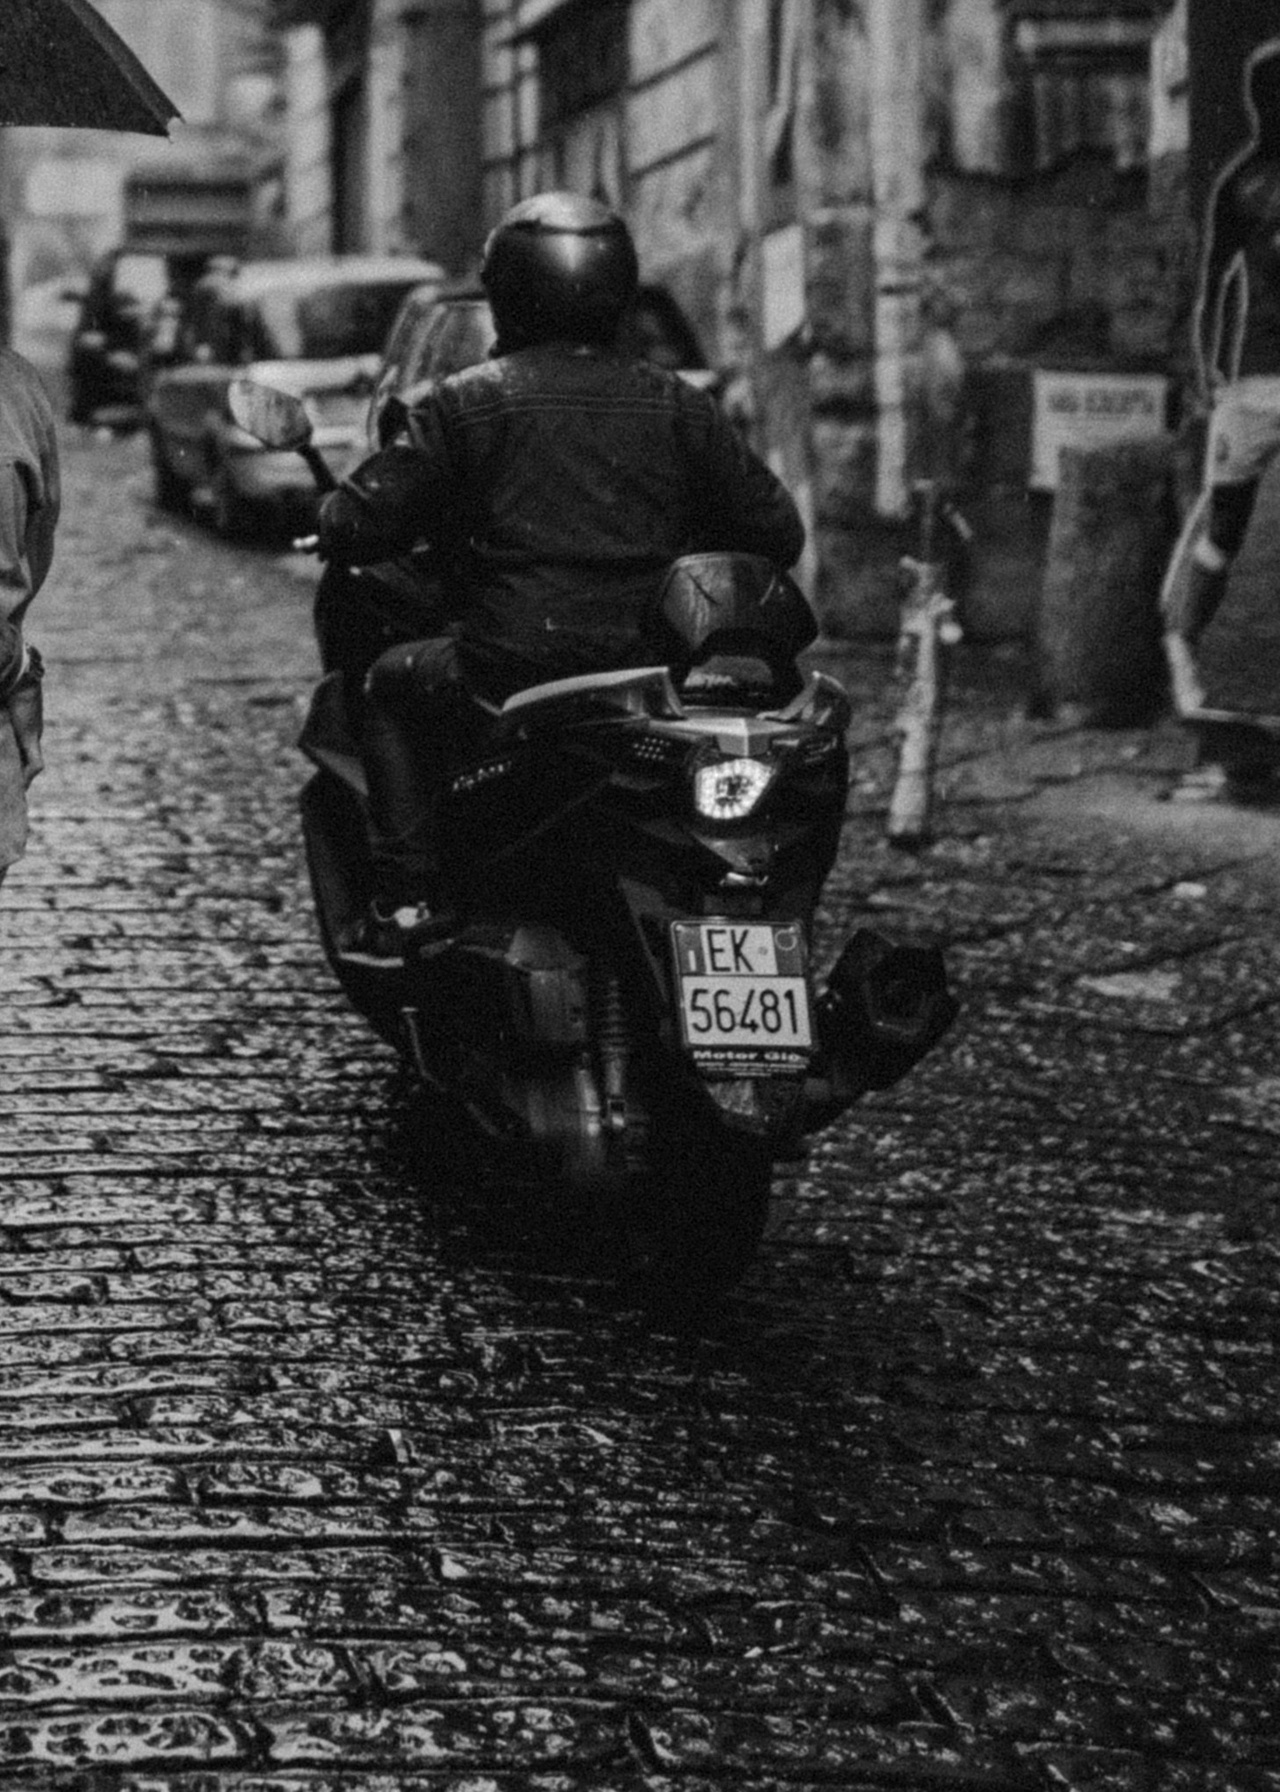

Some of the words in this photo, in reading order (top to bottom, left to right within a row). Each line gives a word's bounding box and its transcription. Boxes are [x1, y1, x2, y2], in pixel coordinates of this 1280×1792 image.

[707, 929, 754, 972] EK
[690, 988, 798, 1034] 56481
[693, 1050, 758, 1061] Motor
